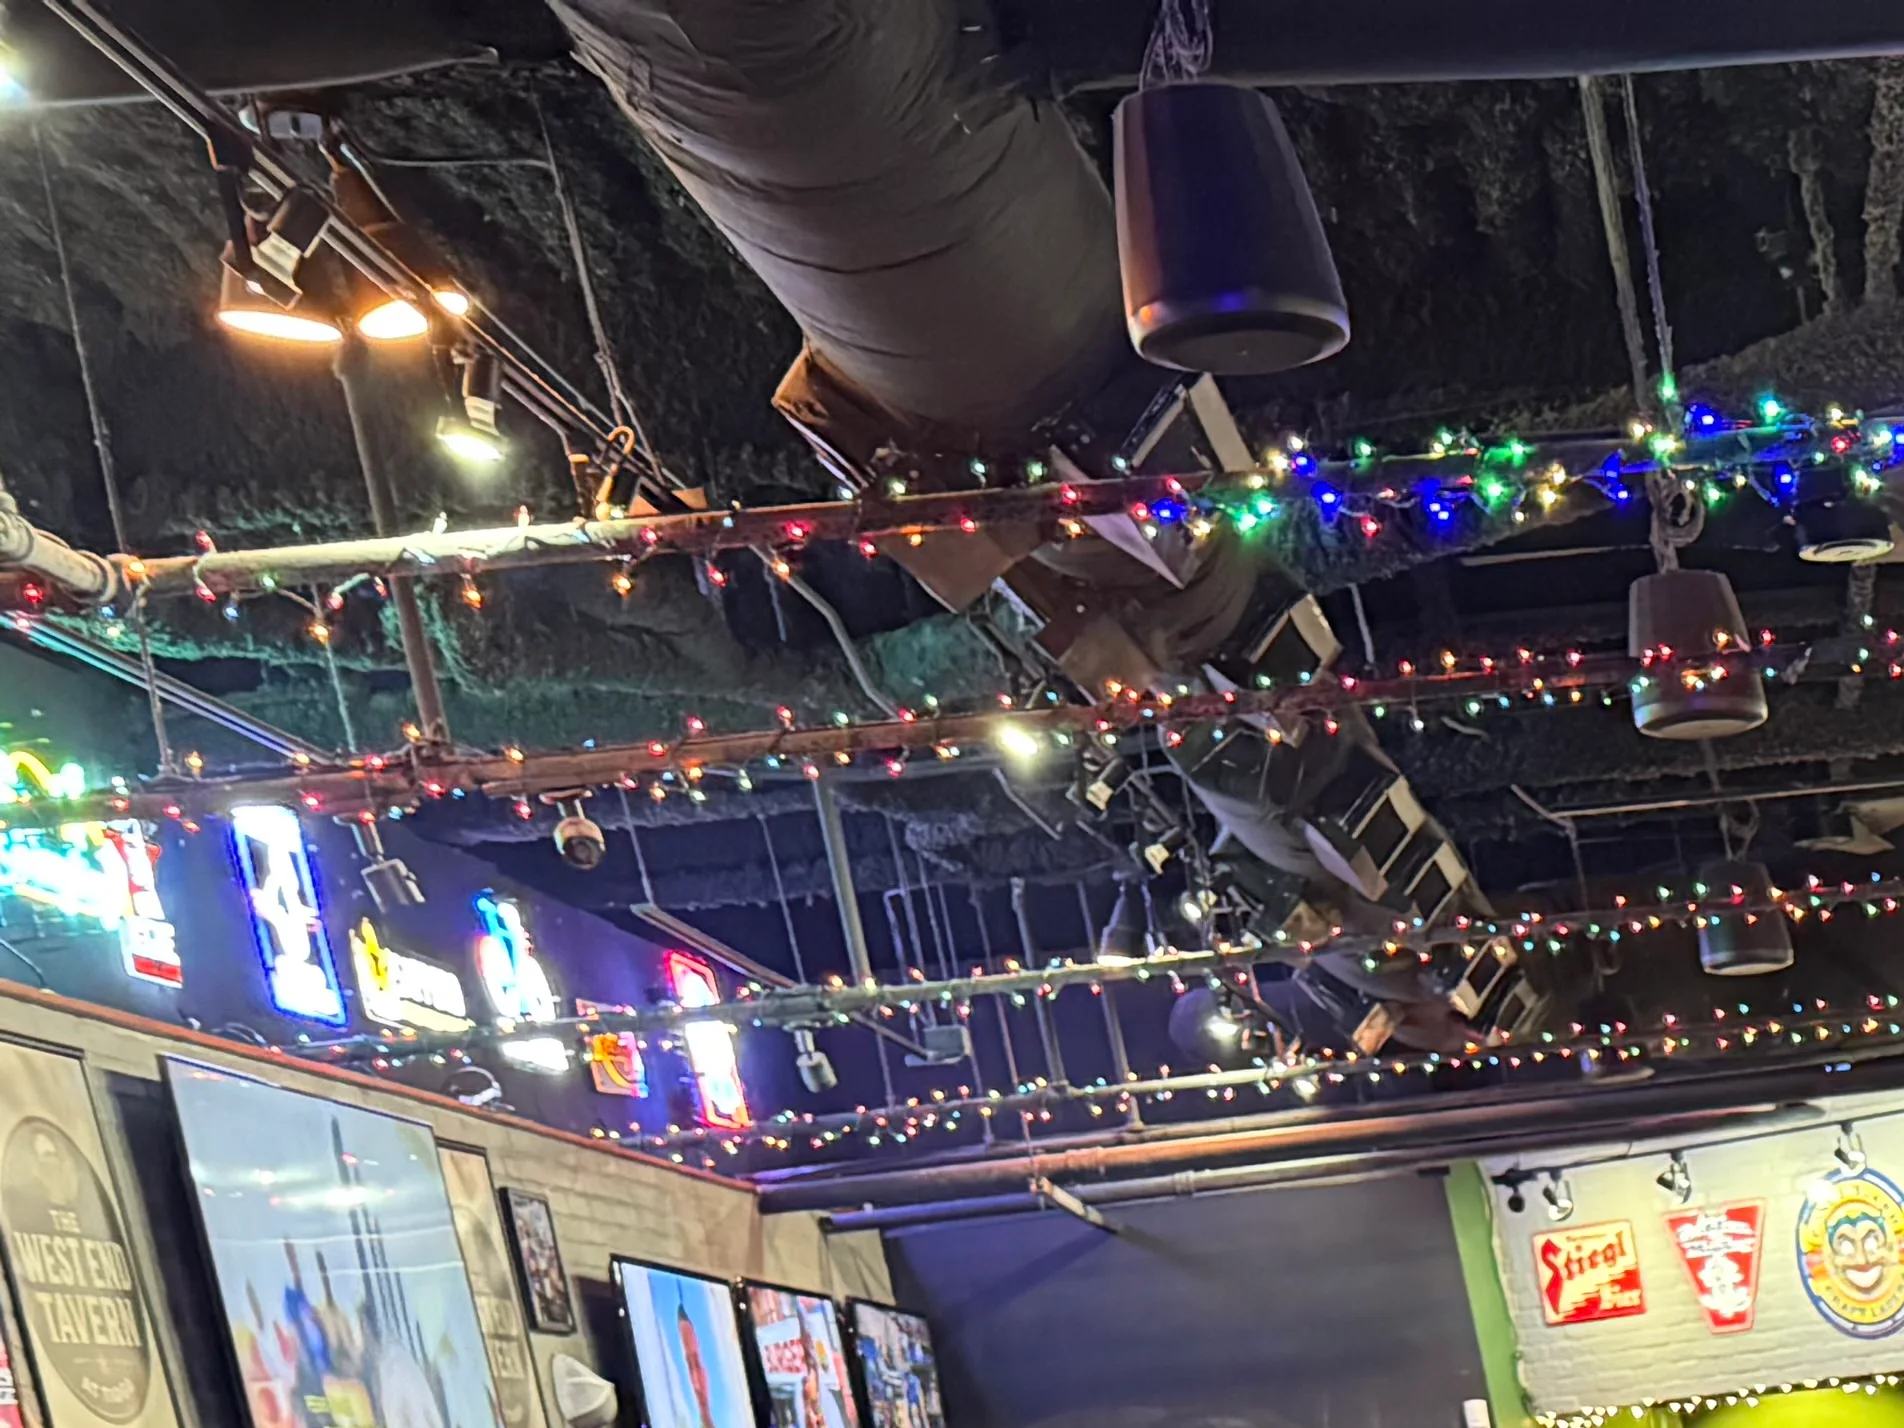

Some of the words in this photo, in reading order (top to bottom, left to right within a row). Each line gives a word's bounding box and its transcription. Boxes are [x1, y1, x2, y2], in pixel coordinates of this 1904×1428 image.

[48, 1207, 81, 1234] THE
[13, 1230, 85, 1289] WEST
[85, 1240, 133, 1291] END
[35, 1290, 142, 1347] TAVERN
